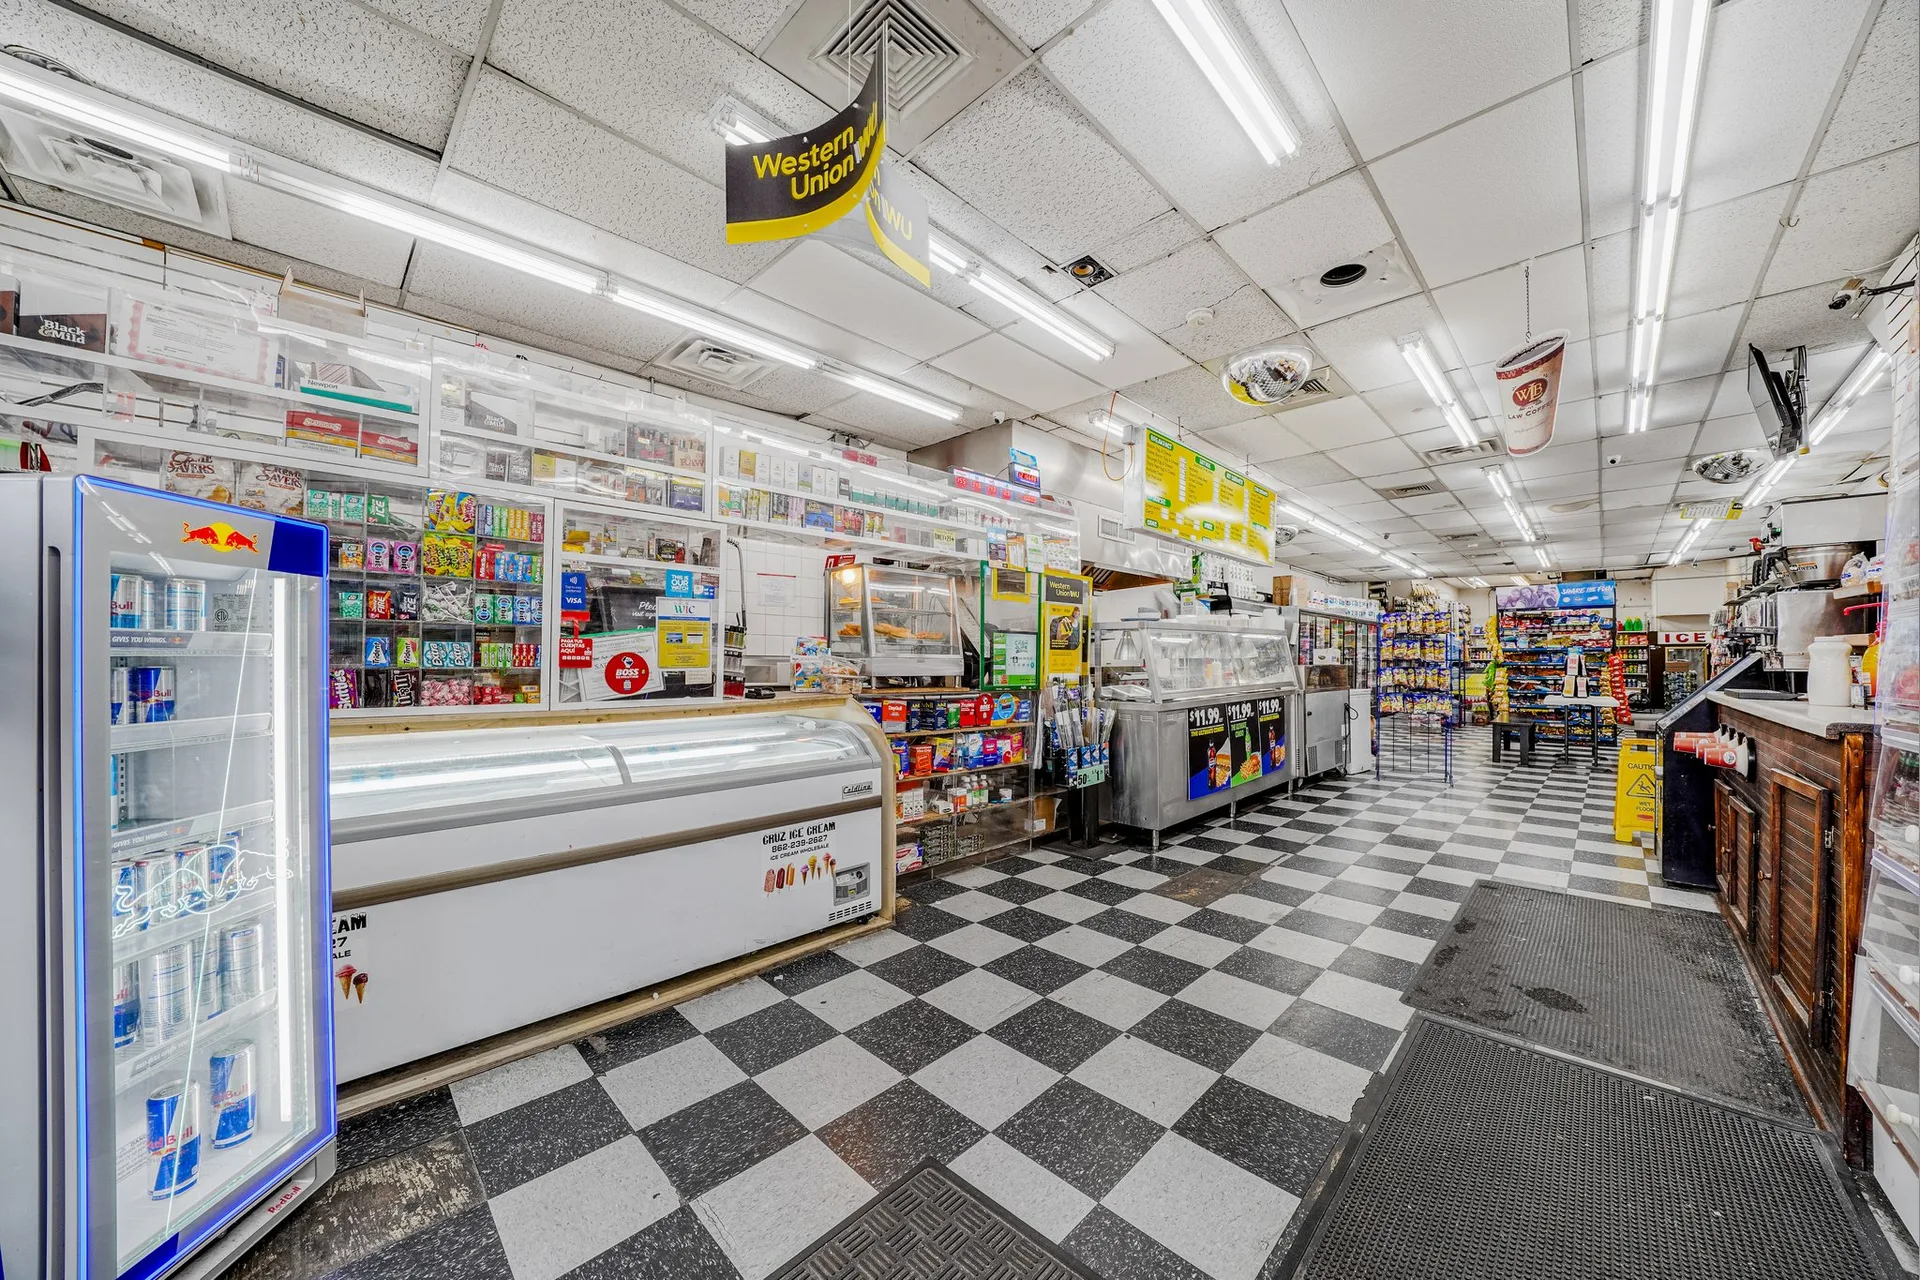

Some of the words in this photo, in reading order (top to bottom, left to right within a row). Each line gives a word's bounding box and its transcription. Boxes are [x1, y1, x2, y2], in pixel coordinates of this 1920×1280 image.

[753, 126, 854, 179] Western
[790, 155, 854, 200] Union
[44, 319, 85, 335] Black
[307, 380, 338, 390] Newport
[376, 500, 385, 517] ICE
[370, 541, 387, 569] Orbit
[397, 545, 413, 571] Orbit
[1049, 581, 1071, 590] Western
[1056, 589, 1070, 597] Union
[110, 601, 133, 610] Bull
[376, 595, 385, 614] FIRE
[407, 596, 417, 614] ICE
[638, 601, 656, 611] Plea
[1664, 632, 1706, 643] ICE
[372, 641, 381, 665] Trident
[153, 689, 171, 697] Bull
[335, 669, 352, 709] Skittles
[1228, 703, 1251, 720] $11.99
[1259, 699, 1279, 715] $11.99
[1189, 707, 1220, 727] $11.99
[1628, 763, 1655, 771] CAUTIO
[842, 784, 873, 795] Coldline
[762, 831, 787, 846] CRUZ
[789, 827, 804, 840] ICE
[806, 821, 836, 836] CREAM
[771, 834, 828, 853] 862-239-2627
[780, 850, 799, 859] CREAM
[799, 843, 829, 854] WHOLESALE
[225, 1083, 248, 1100] Bull
